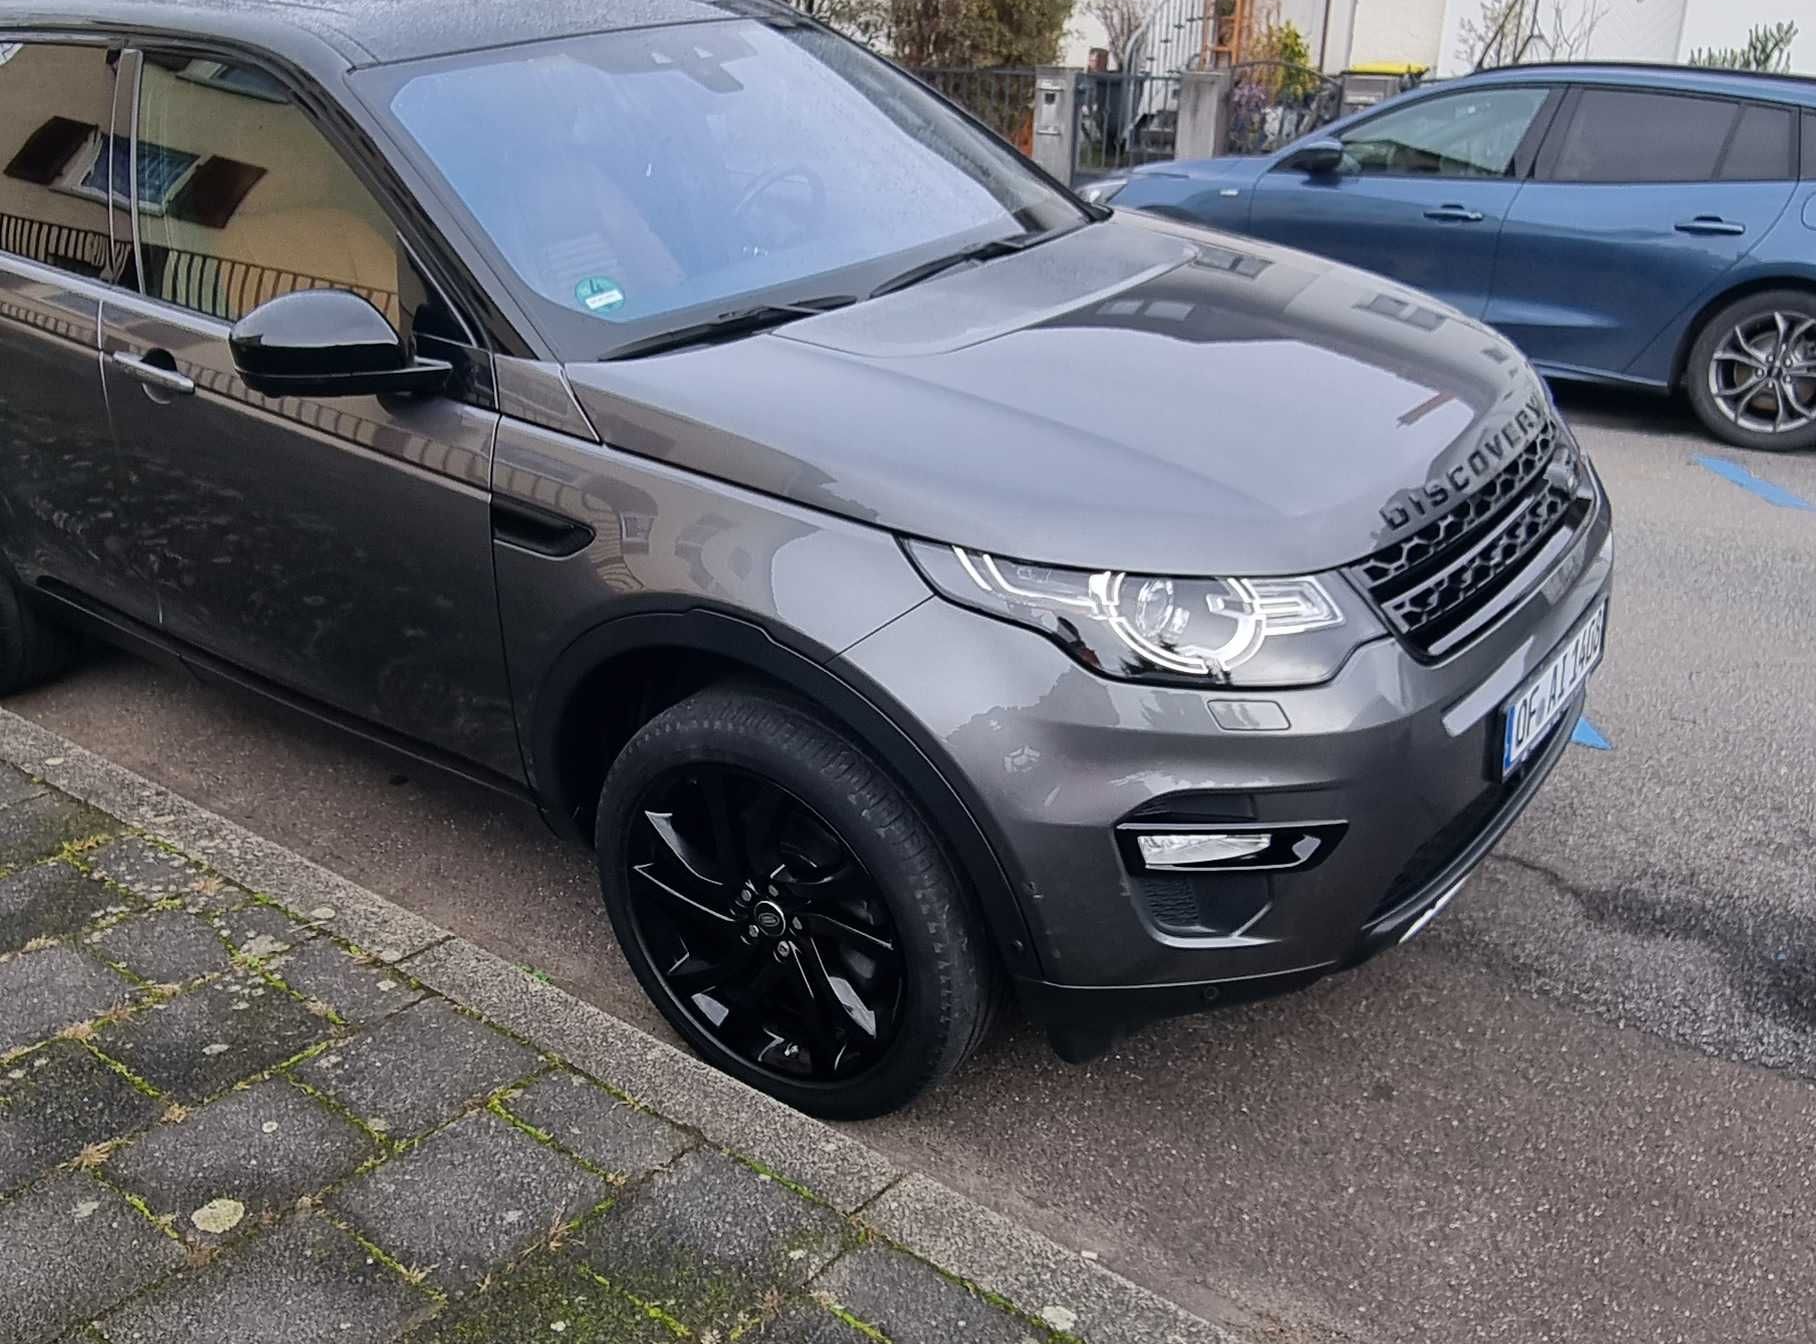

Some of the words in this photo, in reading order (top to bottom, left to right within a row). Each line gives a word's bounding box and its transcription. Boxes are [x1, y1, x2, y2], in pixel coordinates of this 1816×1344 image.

[1379, 392, 1542, 530] DISCOVERY
[1515, 684, 1541, 746] OF
[1546, 652, 1569, 714] AI
